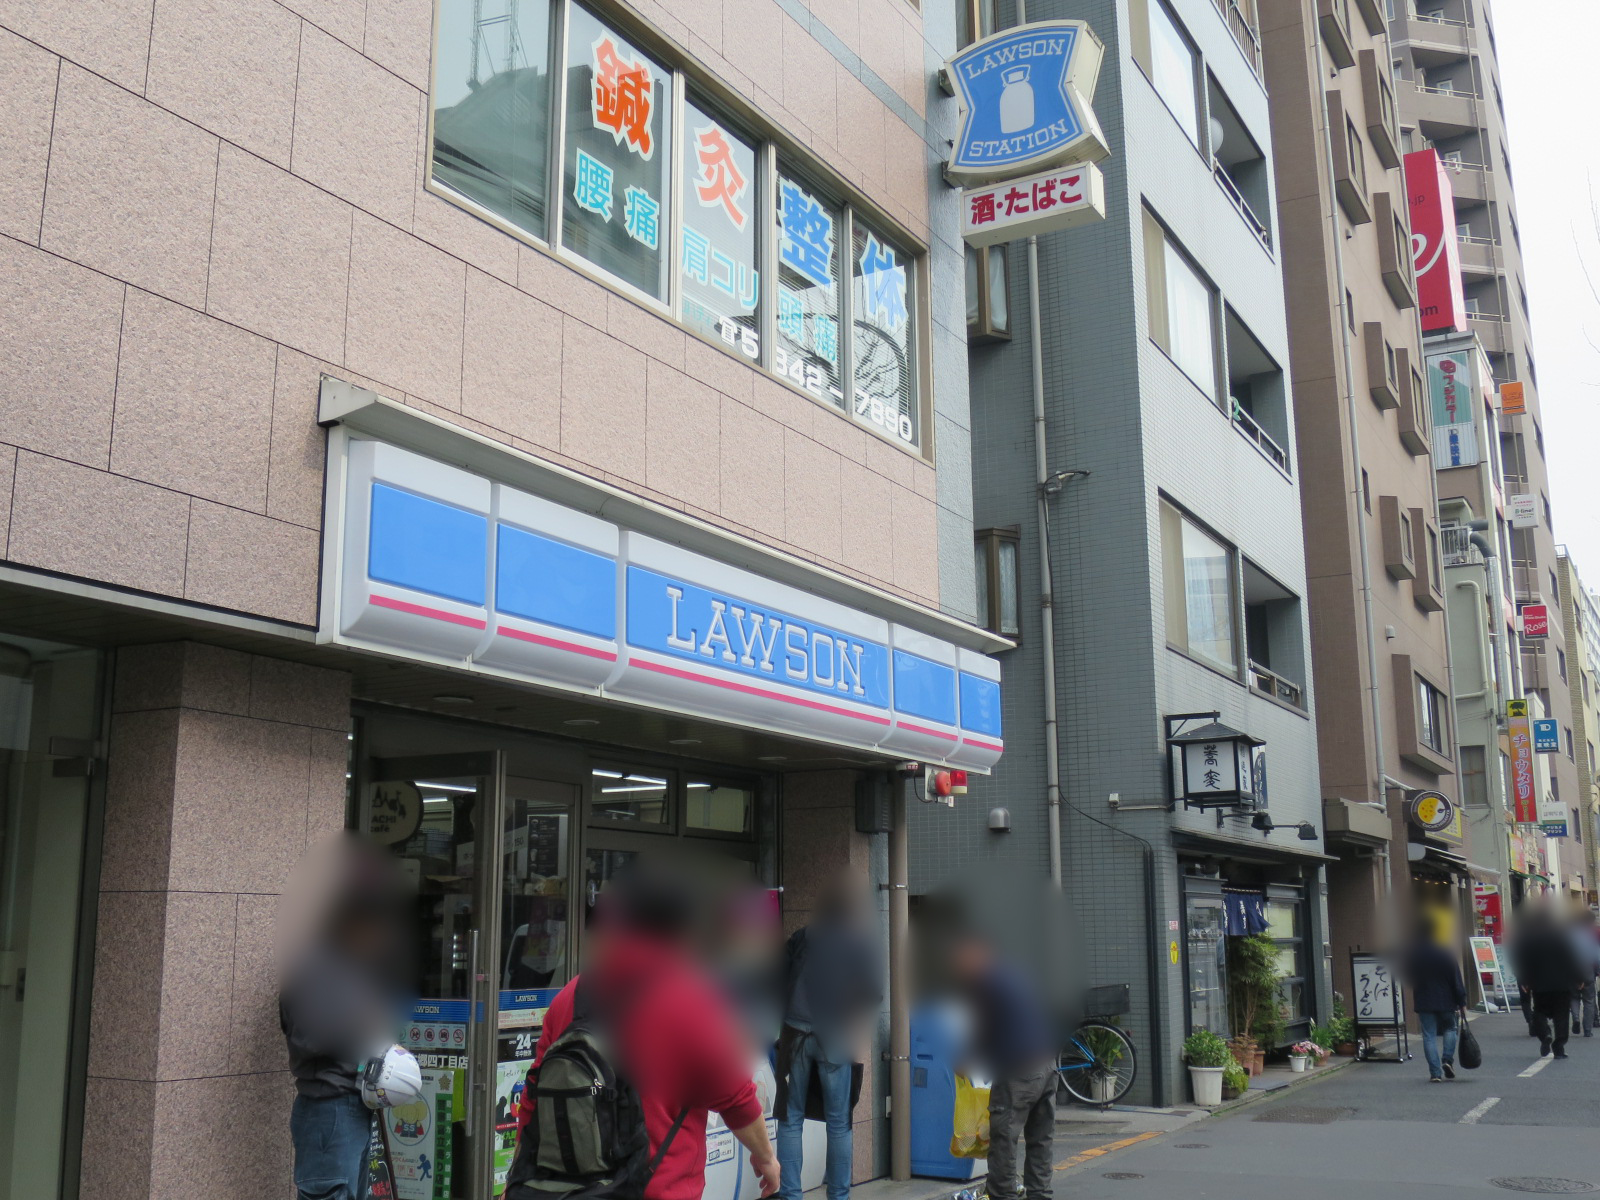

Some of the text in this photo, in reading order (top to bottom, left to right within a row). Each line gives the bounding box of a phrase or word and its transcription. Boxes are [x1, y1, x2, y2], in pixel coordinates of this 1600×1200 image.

[966, 39, 1065, 79] LAWSON
[969, 118, 1068, 157] STATION
[573, 147, 659, 251] 腰痛
[970, 174, 1083, 225] 酒・たばこ
[1407, 194, 1425, 206] .jp
[666, 584, 865, 696] LAWSON
[1513, 734, 1531, 799] チョウタリ
[1359, 973, 1373, 1017] うどん
[1373, 964, 1389, 1002] そば
[415, 1053, 469, 1070] 郷四丁目店
[516, 1033, 532, 1050] 24
